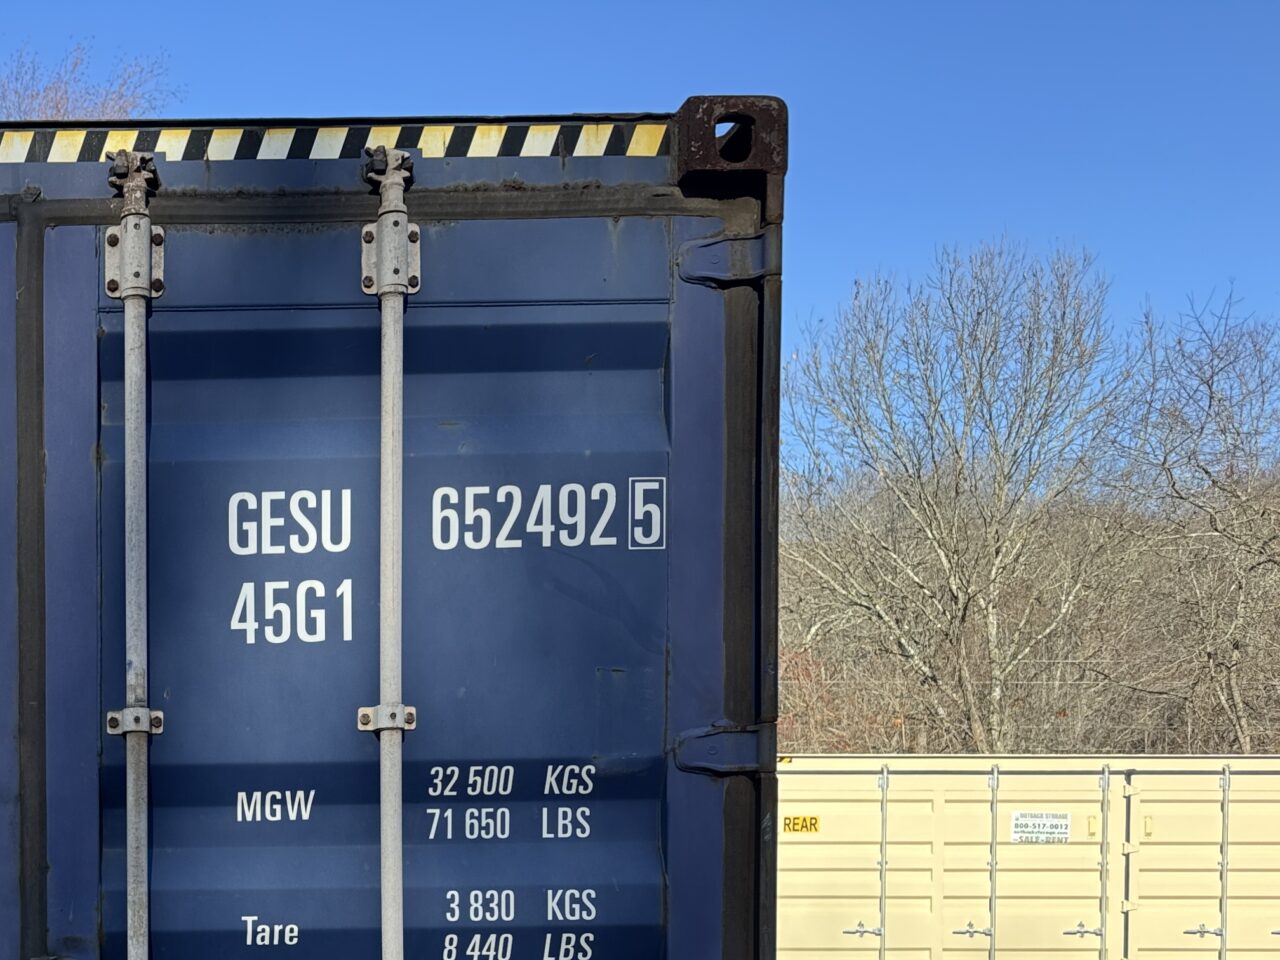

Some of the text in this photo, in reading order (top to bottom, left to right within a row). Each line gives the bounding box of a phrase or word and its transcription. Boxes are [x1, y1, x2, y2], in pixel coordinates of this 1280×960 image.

[228, 480, 663, 556] GESU 652492 5
[230, 579, 353, 644] 45G1
[428, 764, 596, 796] 32 500 KGS
[236, 789, 315, 822] MGW
[426, 806, 591, 839] 71 650 LBS
[783, 816, 818, 832] REAR
[445, 889, 597, 922] 3 830 KGS
[241, 916, 299, 945] Tare
[543, 933, 594, 960] LBS
